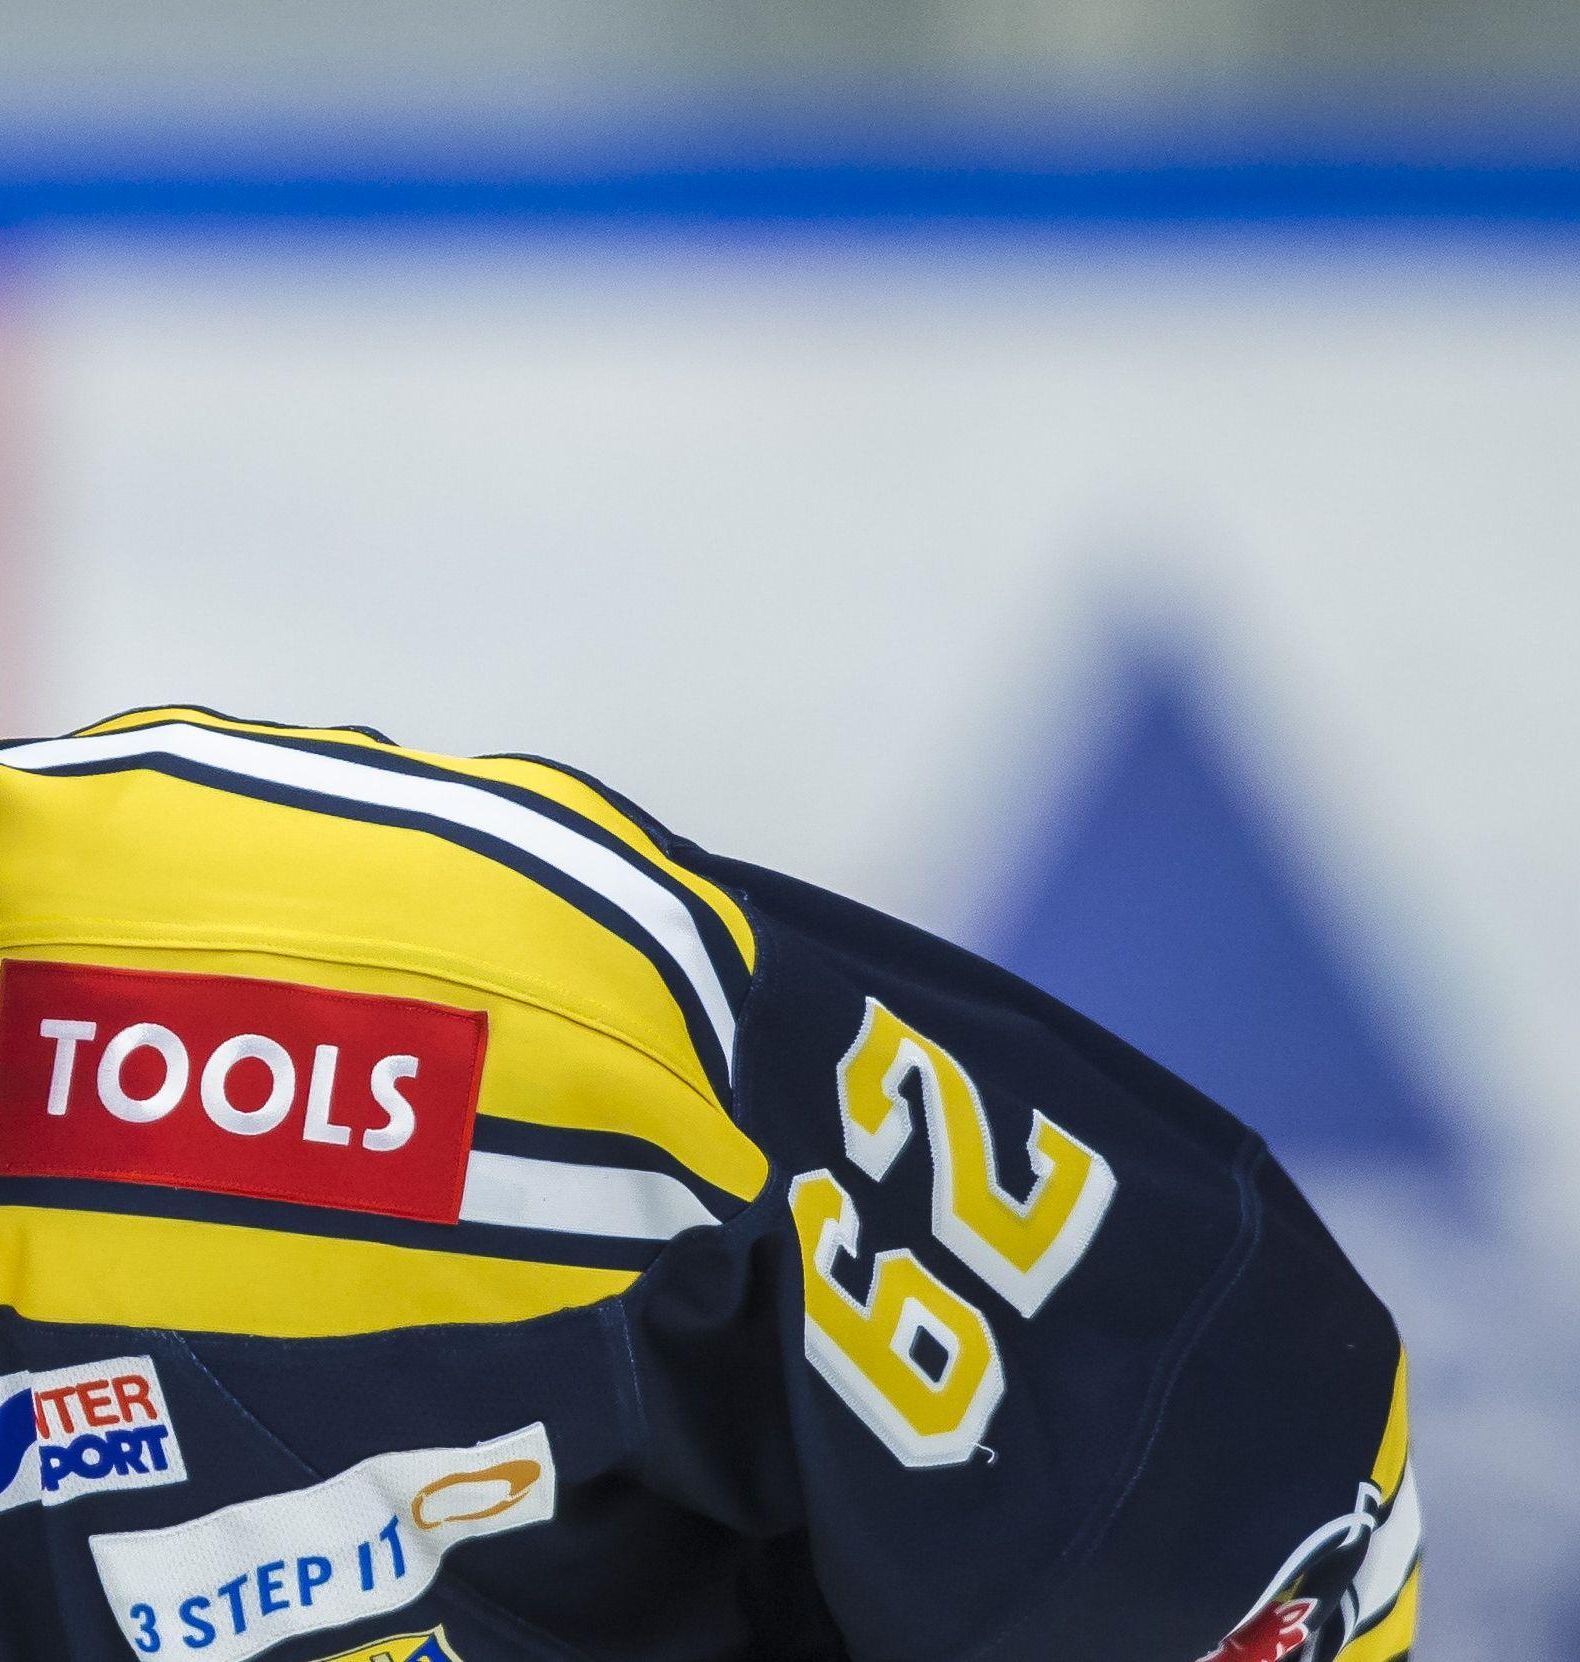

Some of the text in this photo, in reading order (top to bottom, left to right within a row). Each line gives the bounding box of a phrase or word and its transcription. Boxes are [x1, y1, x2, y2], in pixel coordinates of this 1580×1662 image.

[39, 1018, 420, 1152] TOOLS
[788, 997, 1118, 1468] 62
[129, 1514, 407, 1653] 3 STEP IT
